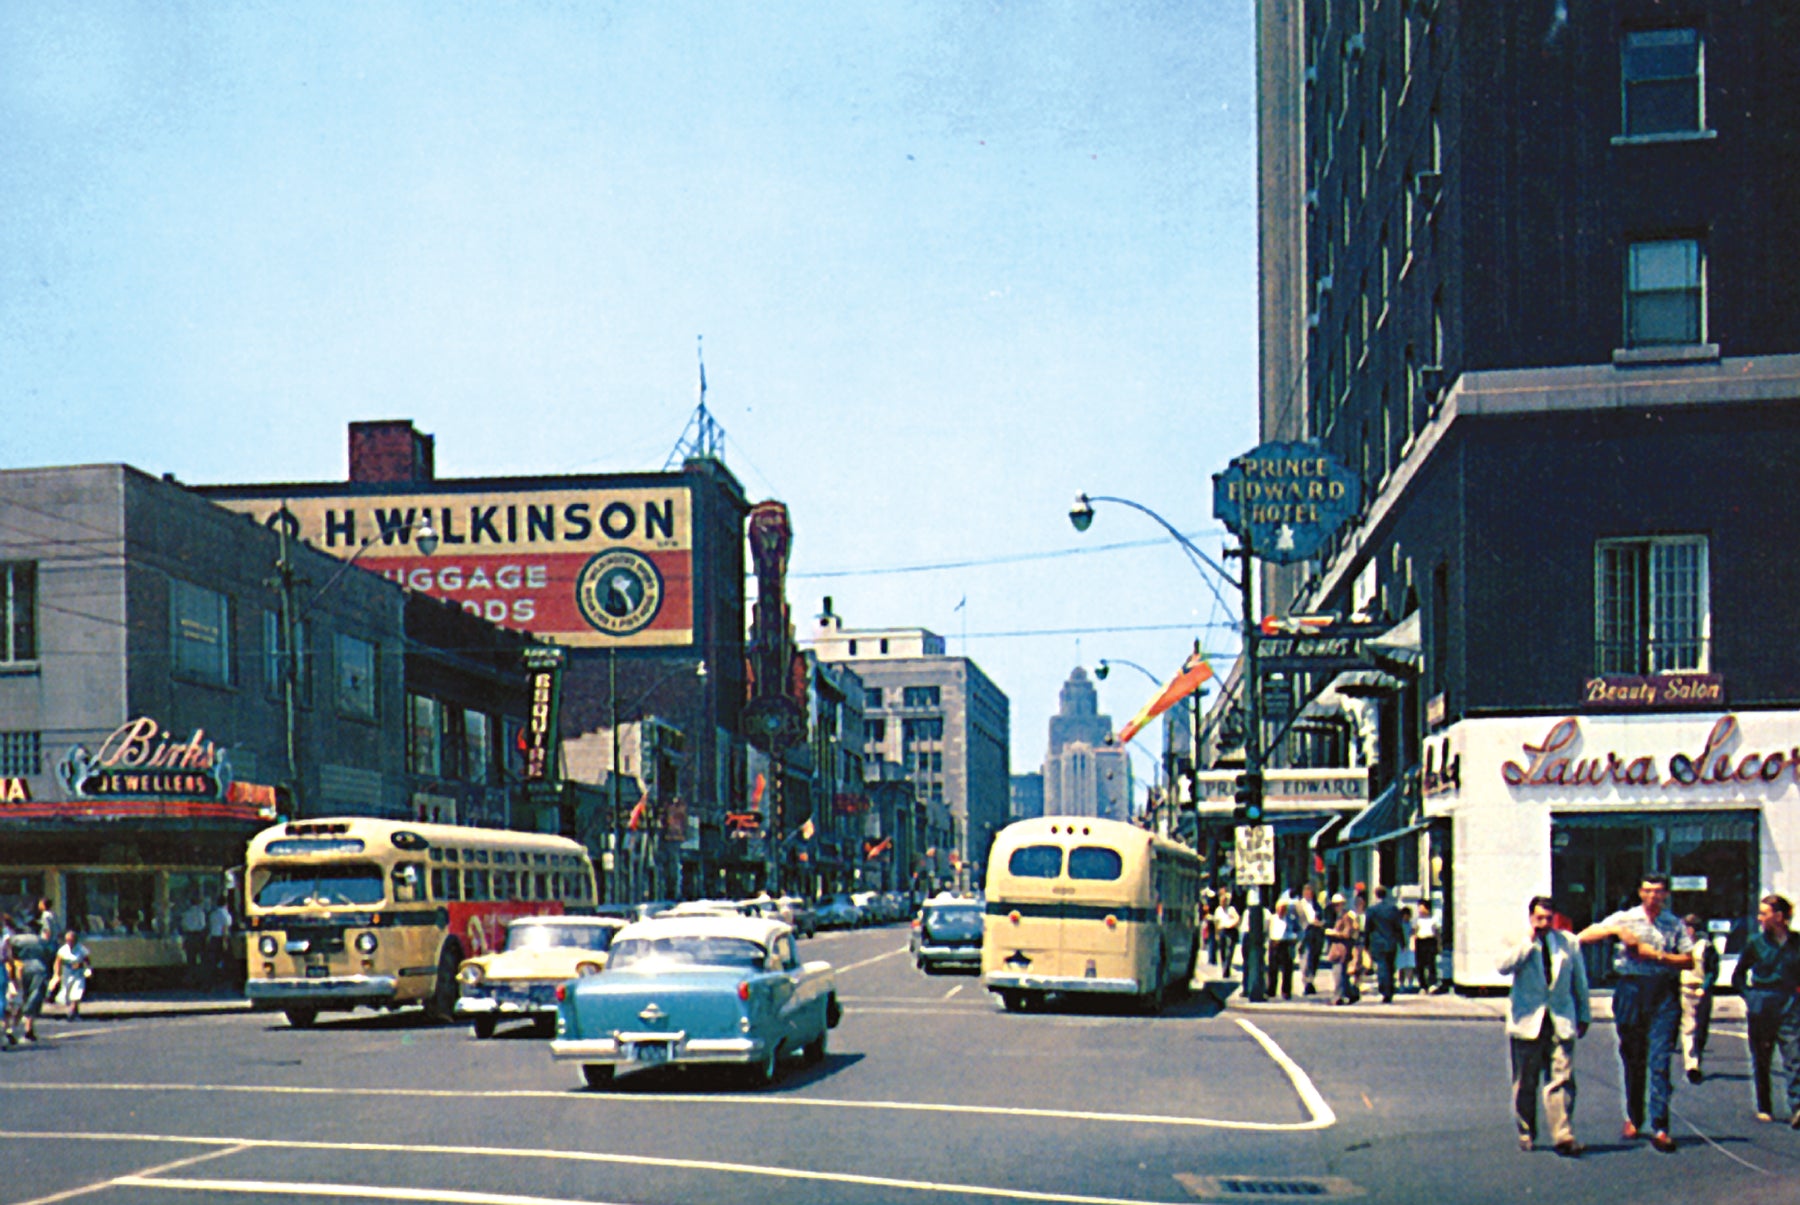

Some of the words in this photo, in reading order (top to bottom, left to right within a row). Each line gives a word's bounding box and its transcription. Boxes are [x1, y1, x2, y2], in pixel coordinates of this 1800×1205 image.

[1244, 458, 1327, 478] PRINCE
[1227, 481, 1346, 500] EDWARD
[1252, 504, 1319, 523] HOTEL
[1586, 677, 1657, 704] Beauty
[1664, 679, 1721, 700] Salon
[101, 716, 215, 768] Birks
[1501, 715, 1660, 785] Laura
[97, 774, 207, 793] JEWELLERS
[1283, 779, 1361, 797] EDWARD
